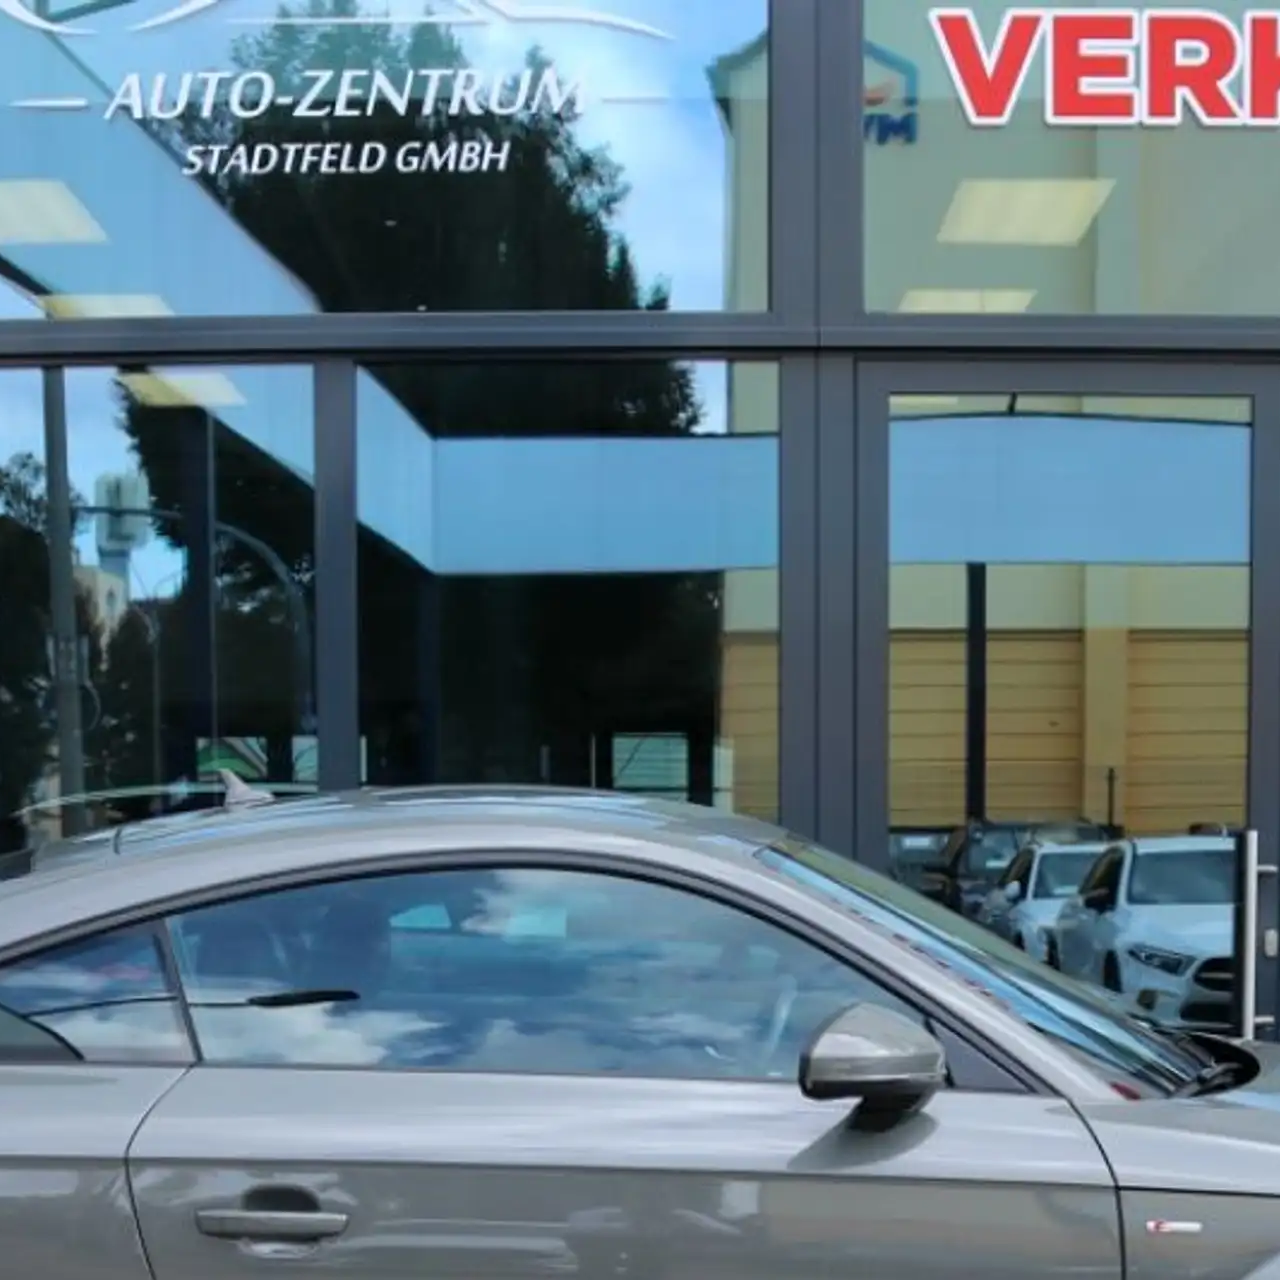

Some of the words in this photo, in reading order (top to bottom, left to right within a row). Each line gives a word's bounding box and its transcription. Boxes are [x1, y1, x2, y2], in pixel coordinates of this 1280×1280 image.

[104, 68, 586, 120] AUTO-ZENTRUM
[183, 142, 389, 176] STADTFELD
[396, 140, 511, 173] GMBH
